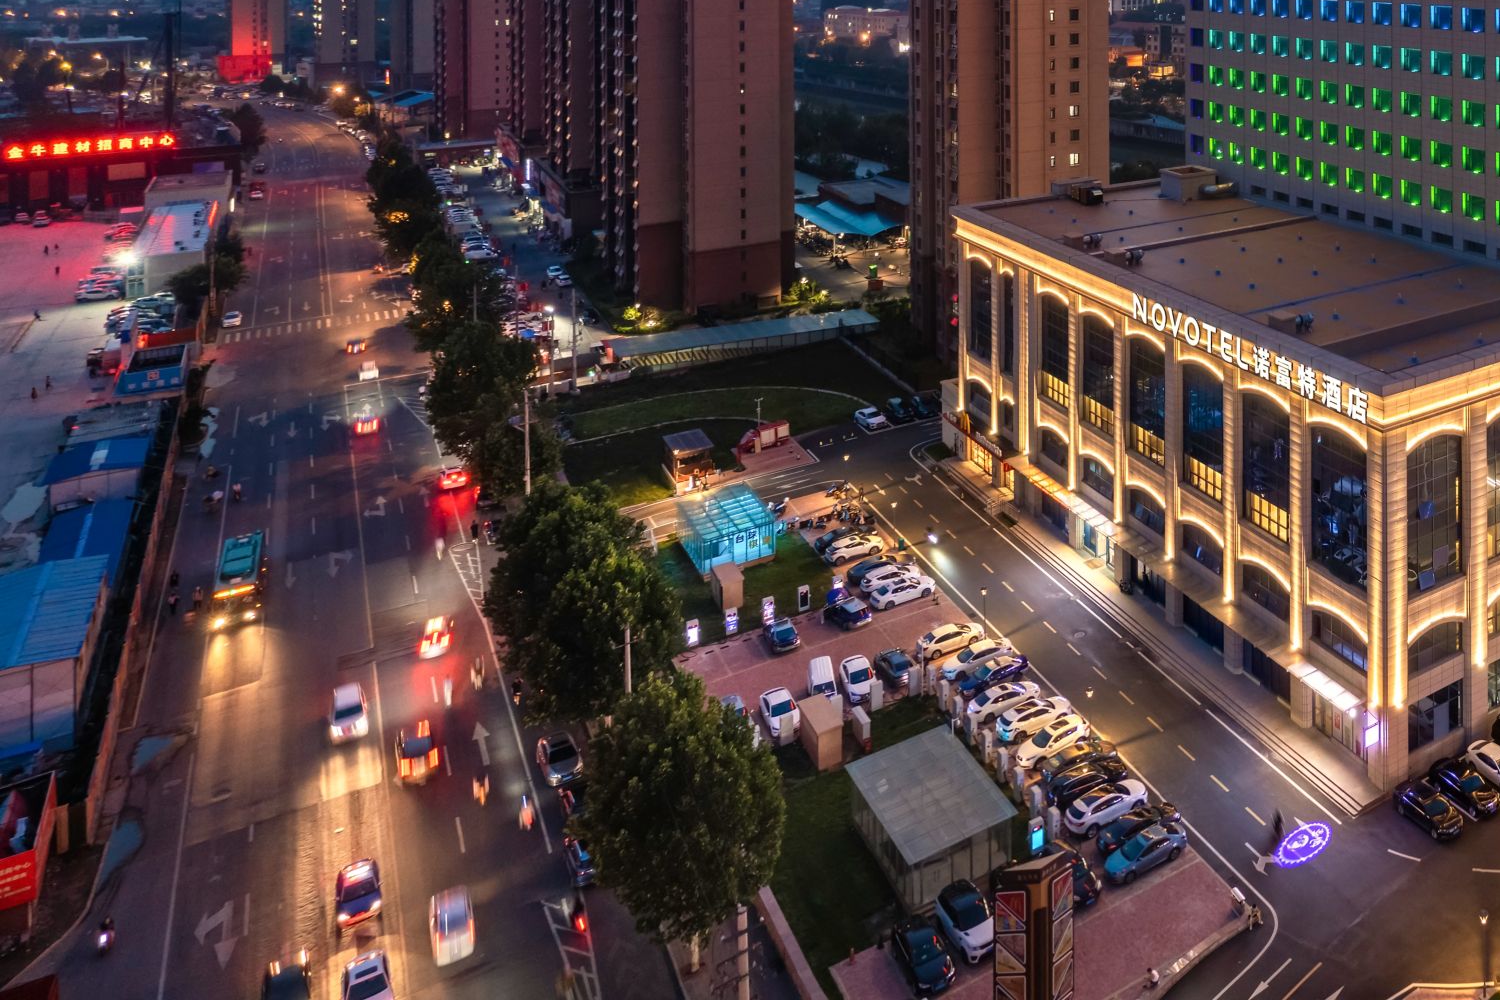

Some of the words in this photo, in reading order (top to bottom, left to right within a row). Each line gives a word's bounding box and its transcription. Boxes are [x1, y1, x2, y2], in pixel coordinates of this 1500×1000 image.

[7, 135, 174, 159] 金牛建材招商中心
[1133, 293, 1249, 371] NOVOTEL
[1252, 346, 1368, 424] 诺富特酒店
